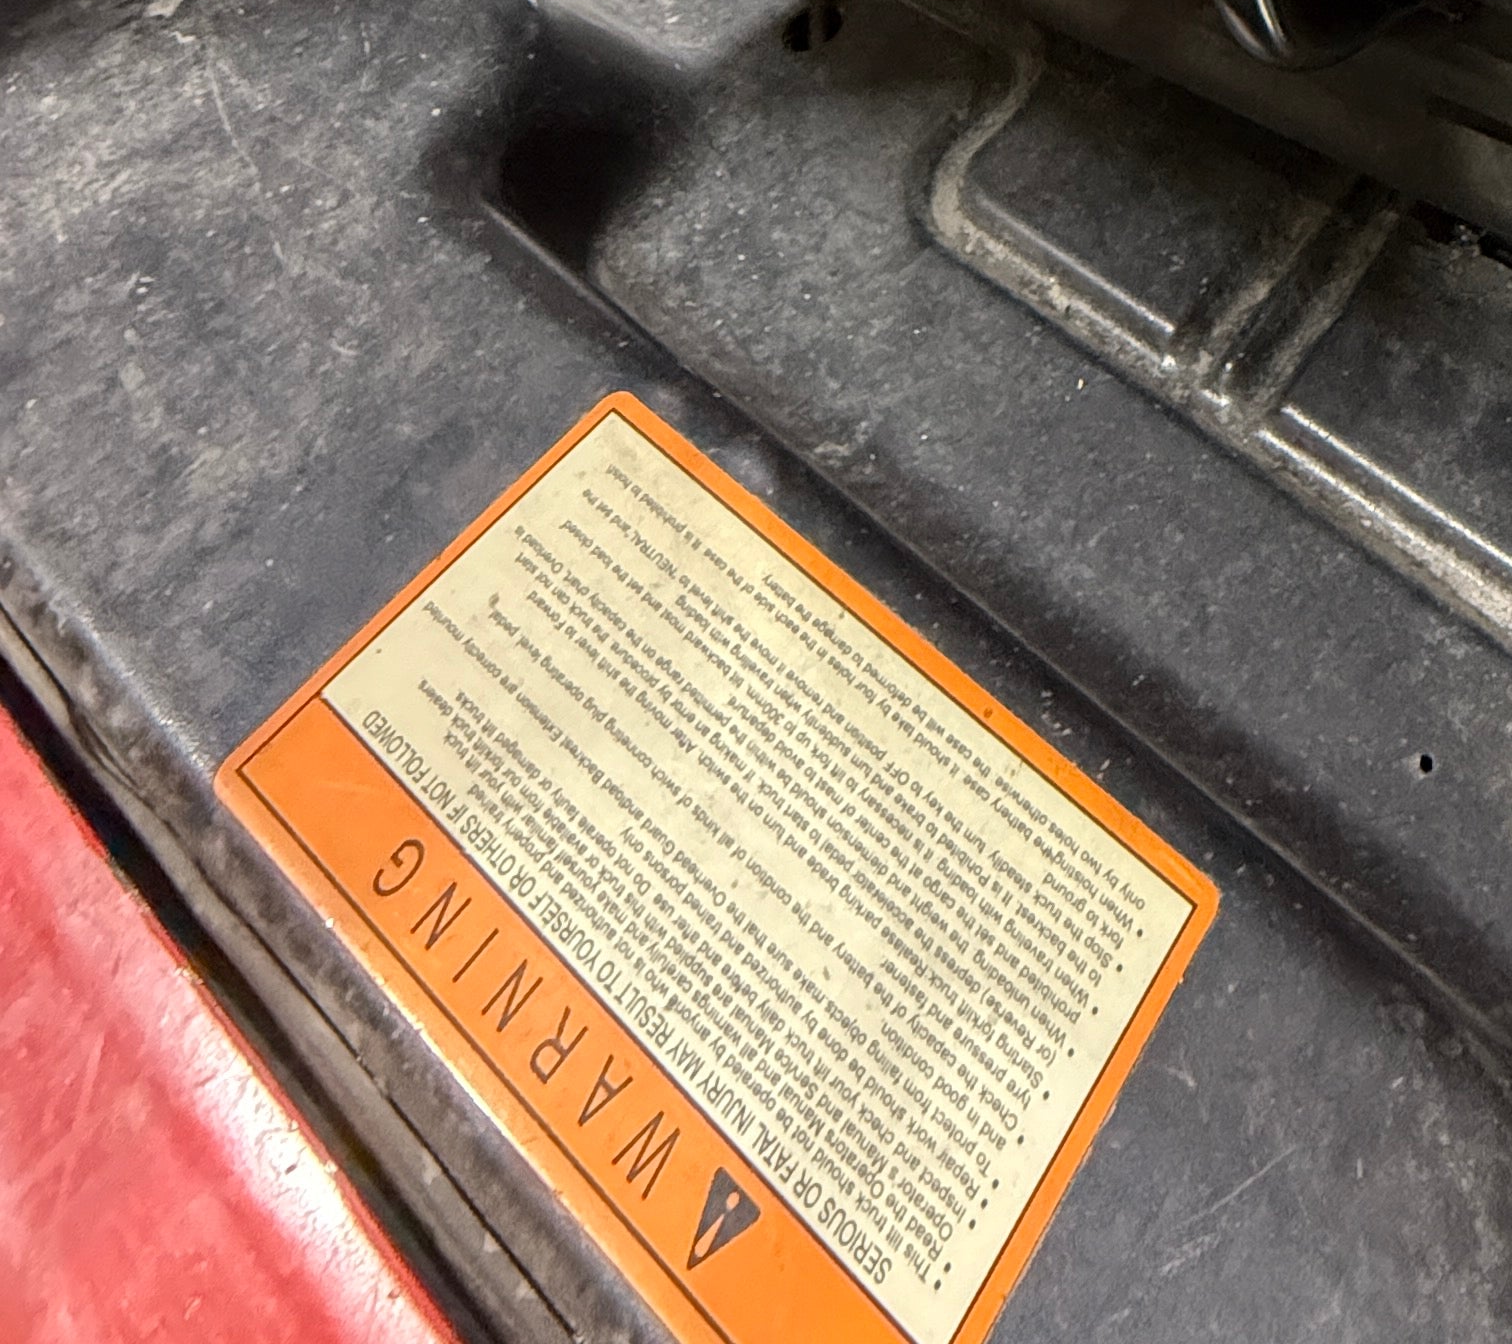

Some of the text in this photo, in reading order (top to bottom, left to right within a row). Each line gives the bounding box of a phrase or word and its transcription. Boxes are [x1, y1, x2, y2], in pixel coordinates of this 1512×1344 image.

[790, 600, 815, 624] the
[807, 612, 856, 659] damage
[859, 659, 914, 711] deformed
[922, 714, 947, 741] will
[943, 730, 974, 761] case
[490, 726, 545, 784] damaged
[770, 736, 807, 774] avoid
[967, 754, 993, 781] the
[545, 782, 584, 824] faulty
[811, 774, 846, 810] mast
[497, 812, 549, 868] properly
[851, 810, 893, 854] center
[537, 856, 567, 889] and
[609, 851, 636, 881] not
[885, 842, 912, 871] the
[1075, 846, 1105, 877] two
[920, 868, 960, 911] cargo
[557, 877, 620, 945] authorized
[668, 911, 702, 949] after
[951, 902, 978, 933] the
[610, 933, 638, 965] not
[693, 937, 724, 972] and
[716, 926, 747, 961] and
[971, 920, 998, 951] set
[991, 938, 1022, 973] and
[1095, 918, 1126, 952] fork
[358, 706, 896, 1288] SERIOUS OR FATAL INJURY MAY RESULT TO YOURSELF OR OTHERS IF NOT FOLLOWED
[639, 964, 672, 1001] who
[715, 959, 760, 1009] before
[738, 948, 804, 1020] authorized
[1015, 957, 1084, 1028] prohibited
[361, 828, 690, 1204] WARNING
[666, 986, 716, 1042] anyone
[923, 999, 955, 1035] and
[780, 1025, 818, 1068] truck
[812, 1023, 851, 1068] done
[950, 1019, 1010, 1083] pressure
[827, 1067, 863, 1109] your
[860, 1071, 909, 1127] should
[929, 1068, 972, 1117] good
[1001, 1071, 1036, 1112] tyre
[788, 1120, 818, 1157] not
[853, 1099, 898, 1151] check
[901, 1113, 940, 1159] work
[975, 1117, 1009, 1156] and
[809, 1142, 859, 1200] should
[890, 1137, 923, 1177] and
[932, 1141, 985, 1202] Repair
[851, 1186, 891, 1235] truck
[915, 1159, 972, 1224] Inspect
[899, 1237, 934, 1281] This
